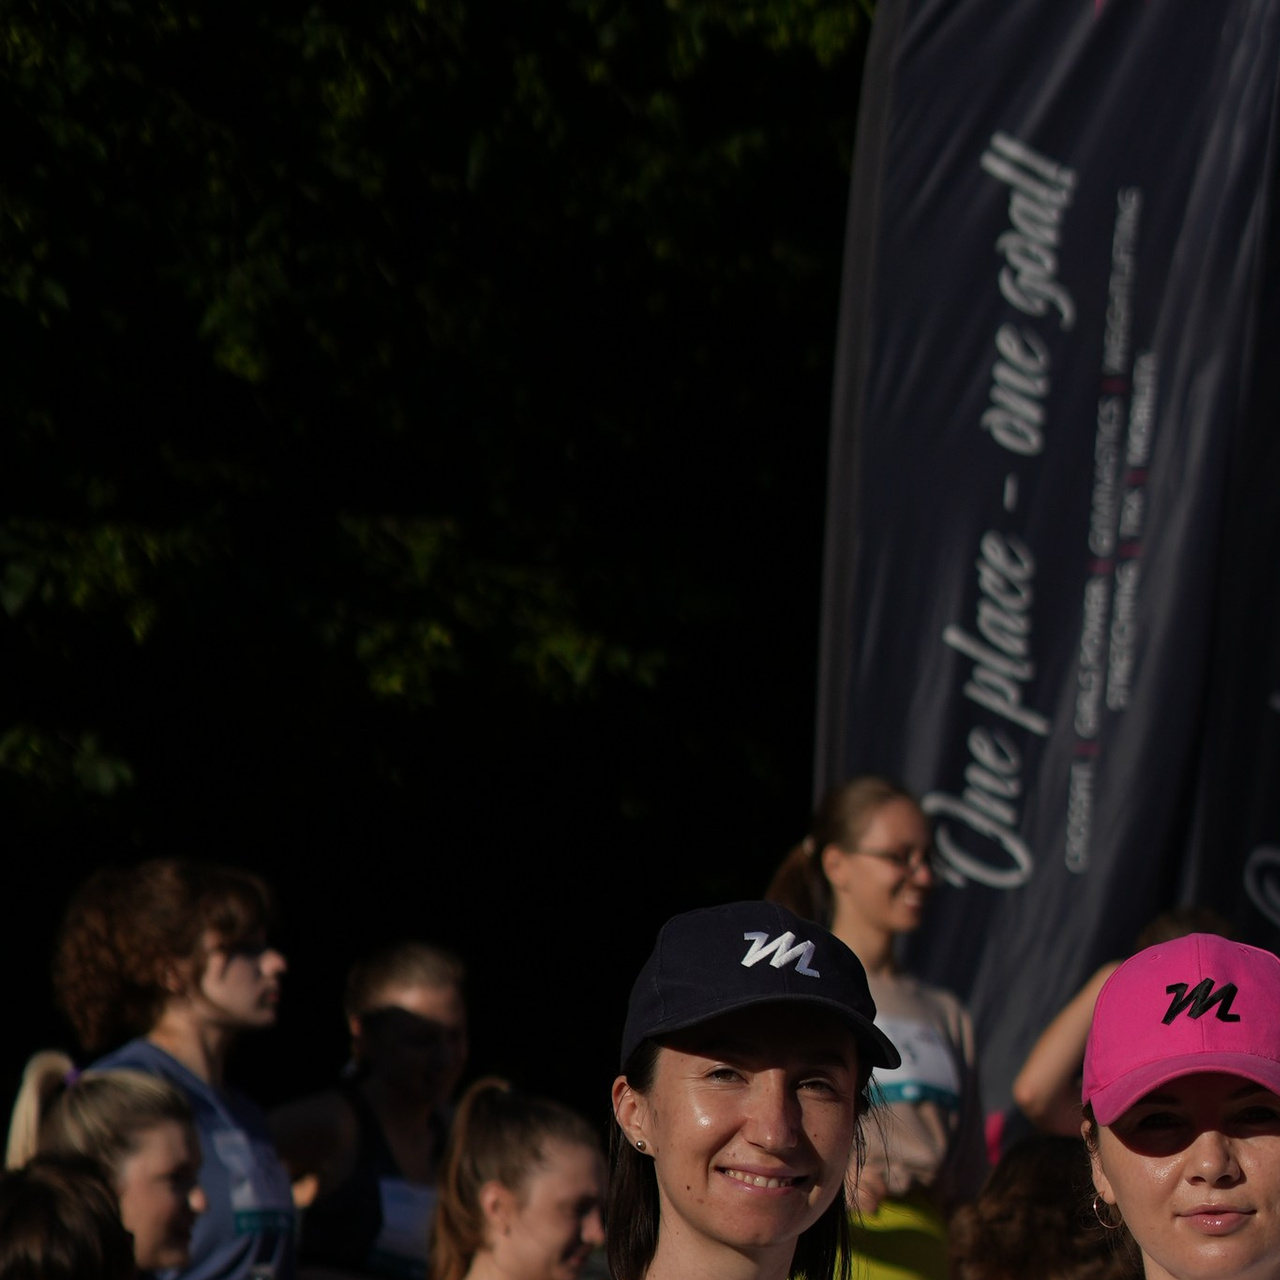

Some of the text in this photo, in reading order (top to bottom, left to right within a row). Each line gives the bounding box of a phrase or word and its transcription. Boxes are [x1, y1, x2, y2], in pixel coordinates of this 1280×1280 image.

[979, 129, 1078, 333] goal!
[979, 322, 1050, 457] one
[942, 528, 1051, 738] place
[921, 725, 1035, 890] One
